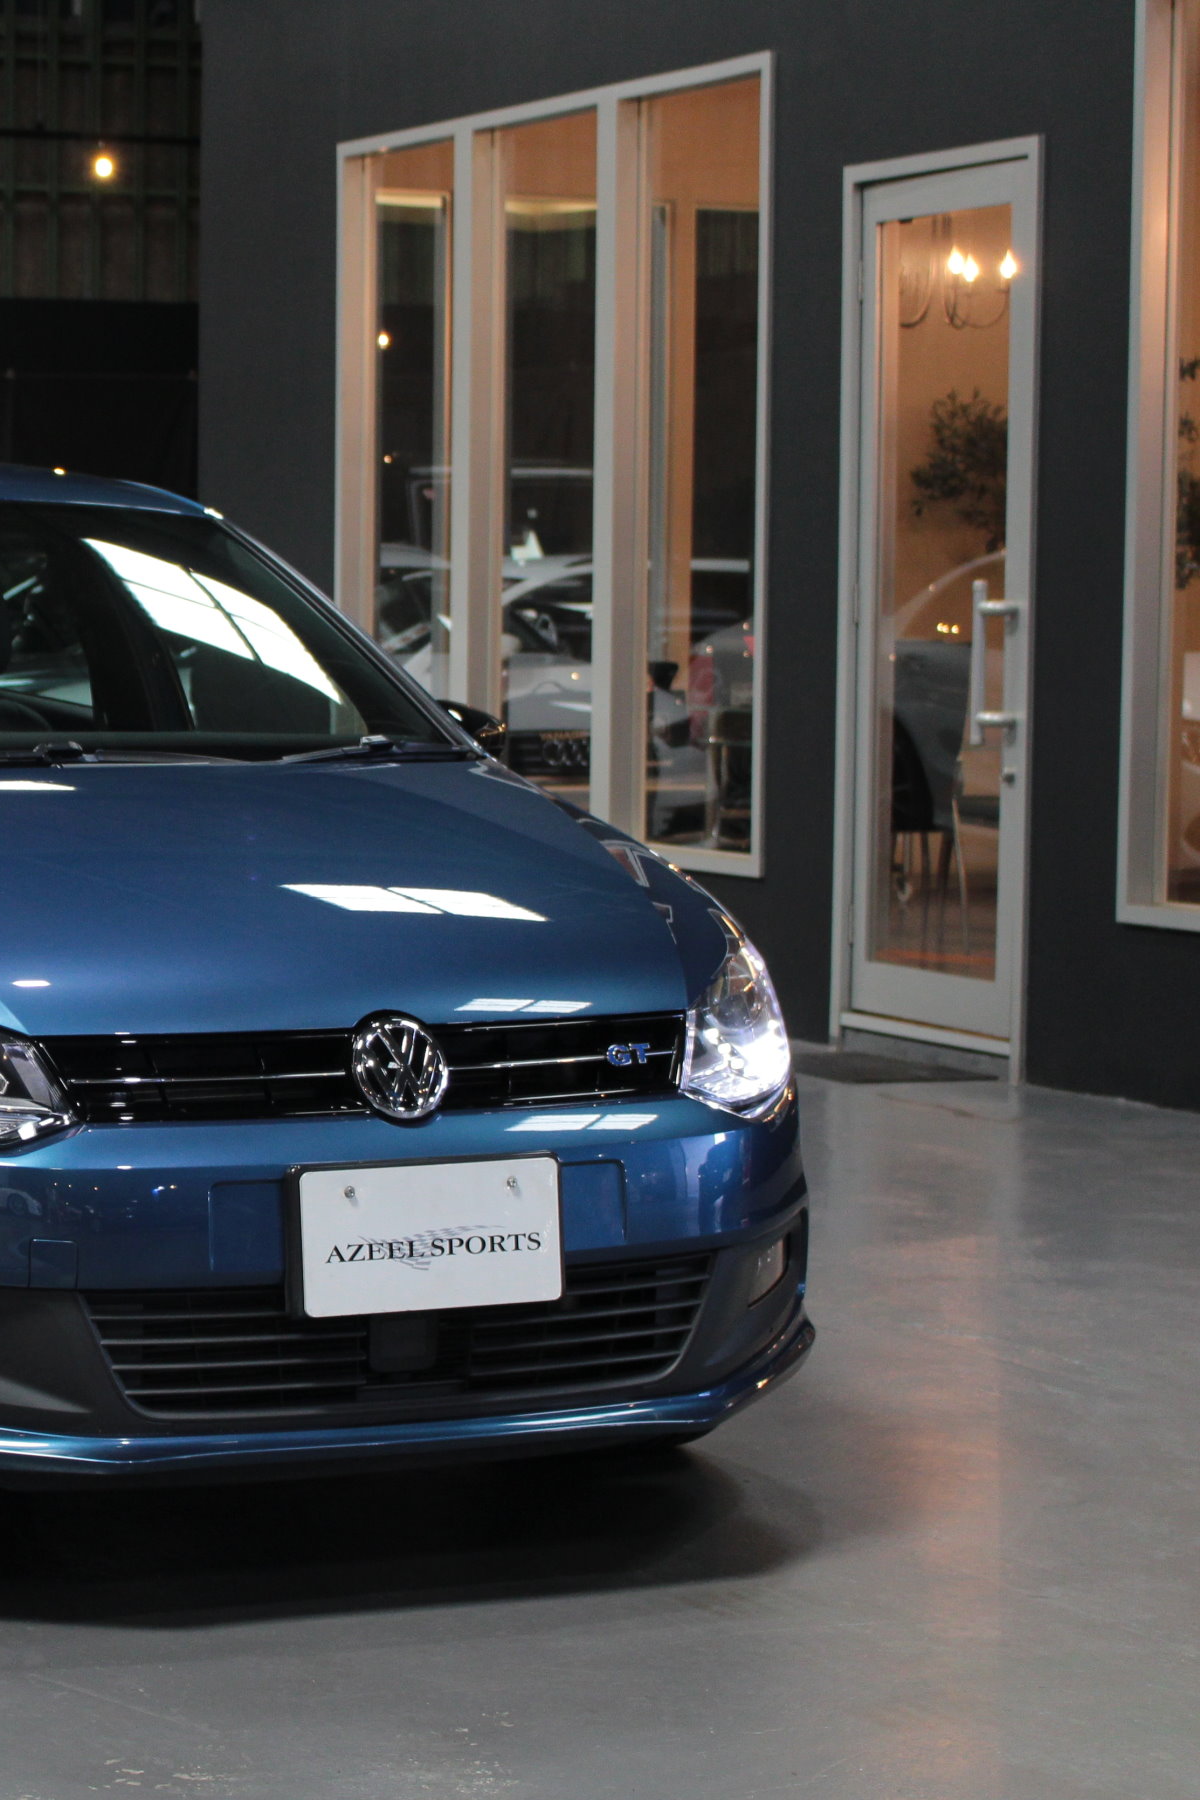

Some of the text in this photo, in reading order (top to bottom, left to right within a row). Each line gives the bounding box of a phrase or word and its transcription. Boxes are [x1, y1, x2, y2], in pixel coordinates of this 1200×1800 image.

[606, 1043, 650, 1066] GT
[326, 1232, 541, 1263] AZEEL SPORTS
